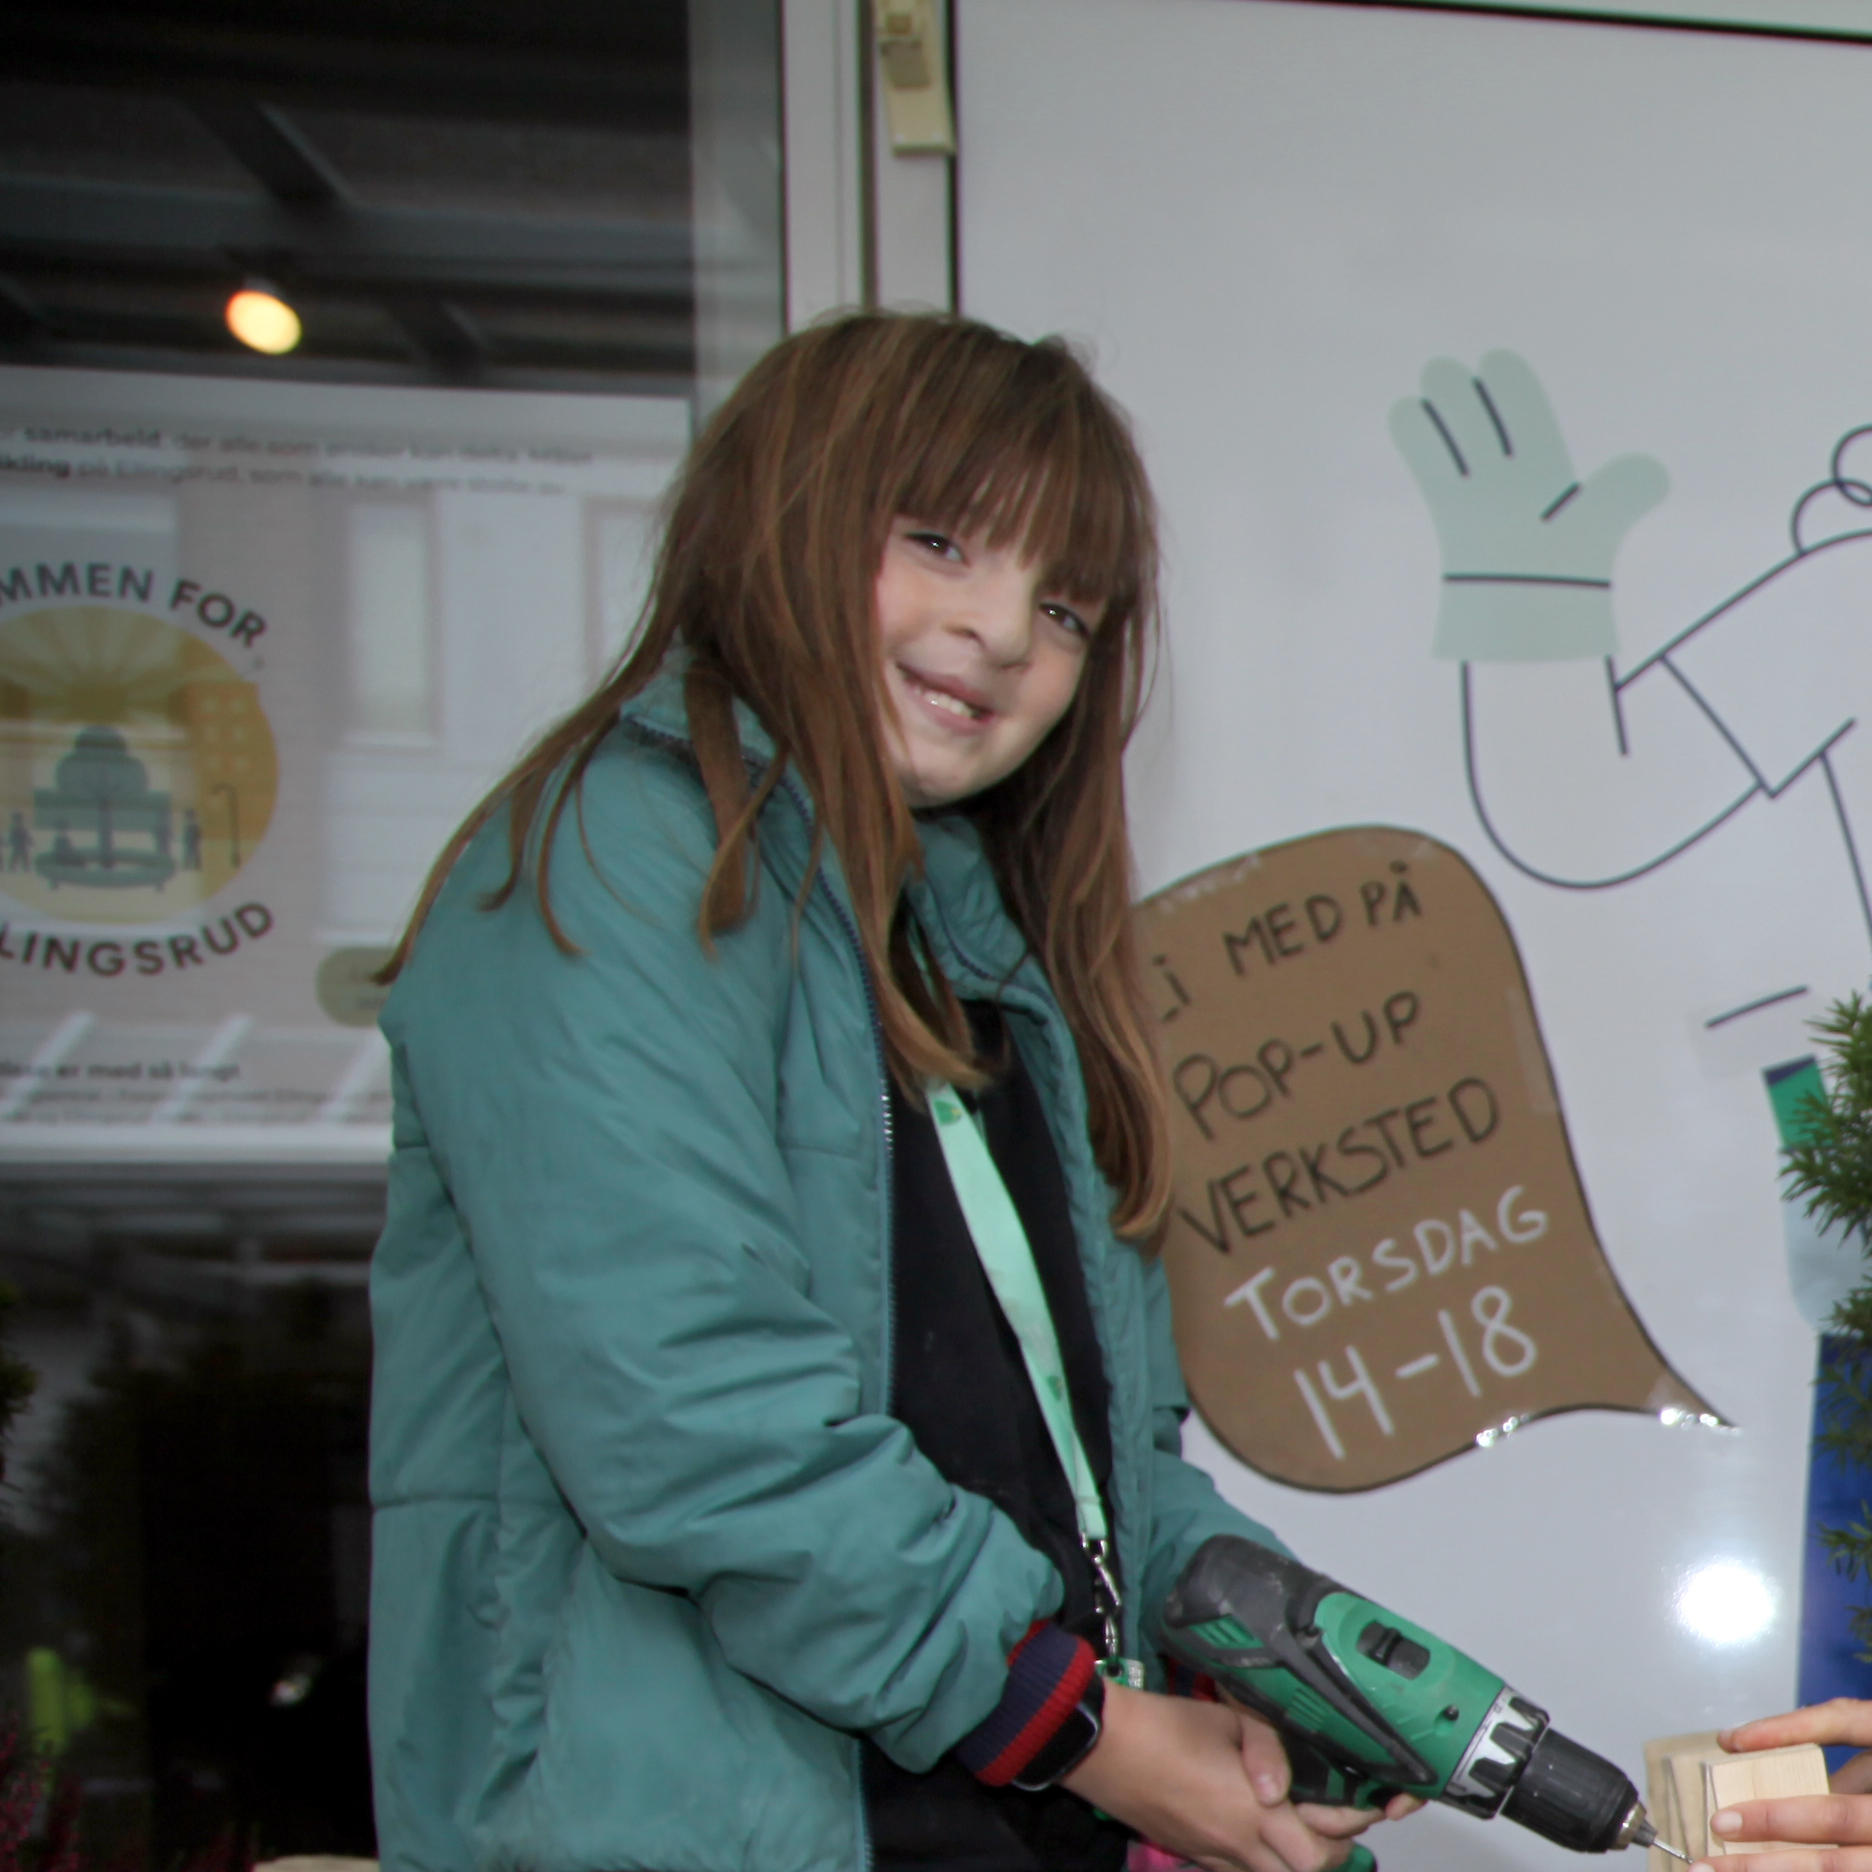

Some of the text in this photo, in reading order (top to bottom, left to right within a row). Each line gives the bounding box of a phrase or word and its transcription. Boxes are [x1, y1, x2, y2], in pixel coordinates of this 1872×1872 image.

[167, 577, 268, 648] FOR
[0, 902, 274, 978] LINGSRUD
[1222, 893, 1342, 977] MED
[1360, 860, 1423, 928] PÅ
[1172, 990, 1420, 1140] POP-UP
[1178, 1076, 1500, 1255] VERKSTED
[1224, 1185, 1549, 1340] TORSDAG
[1294, 1285, 1538, 1460] 14-18
